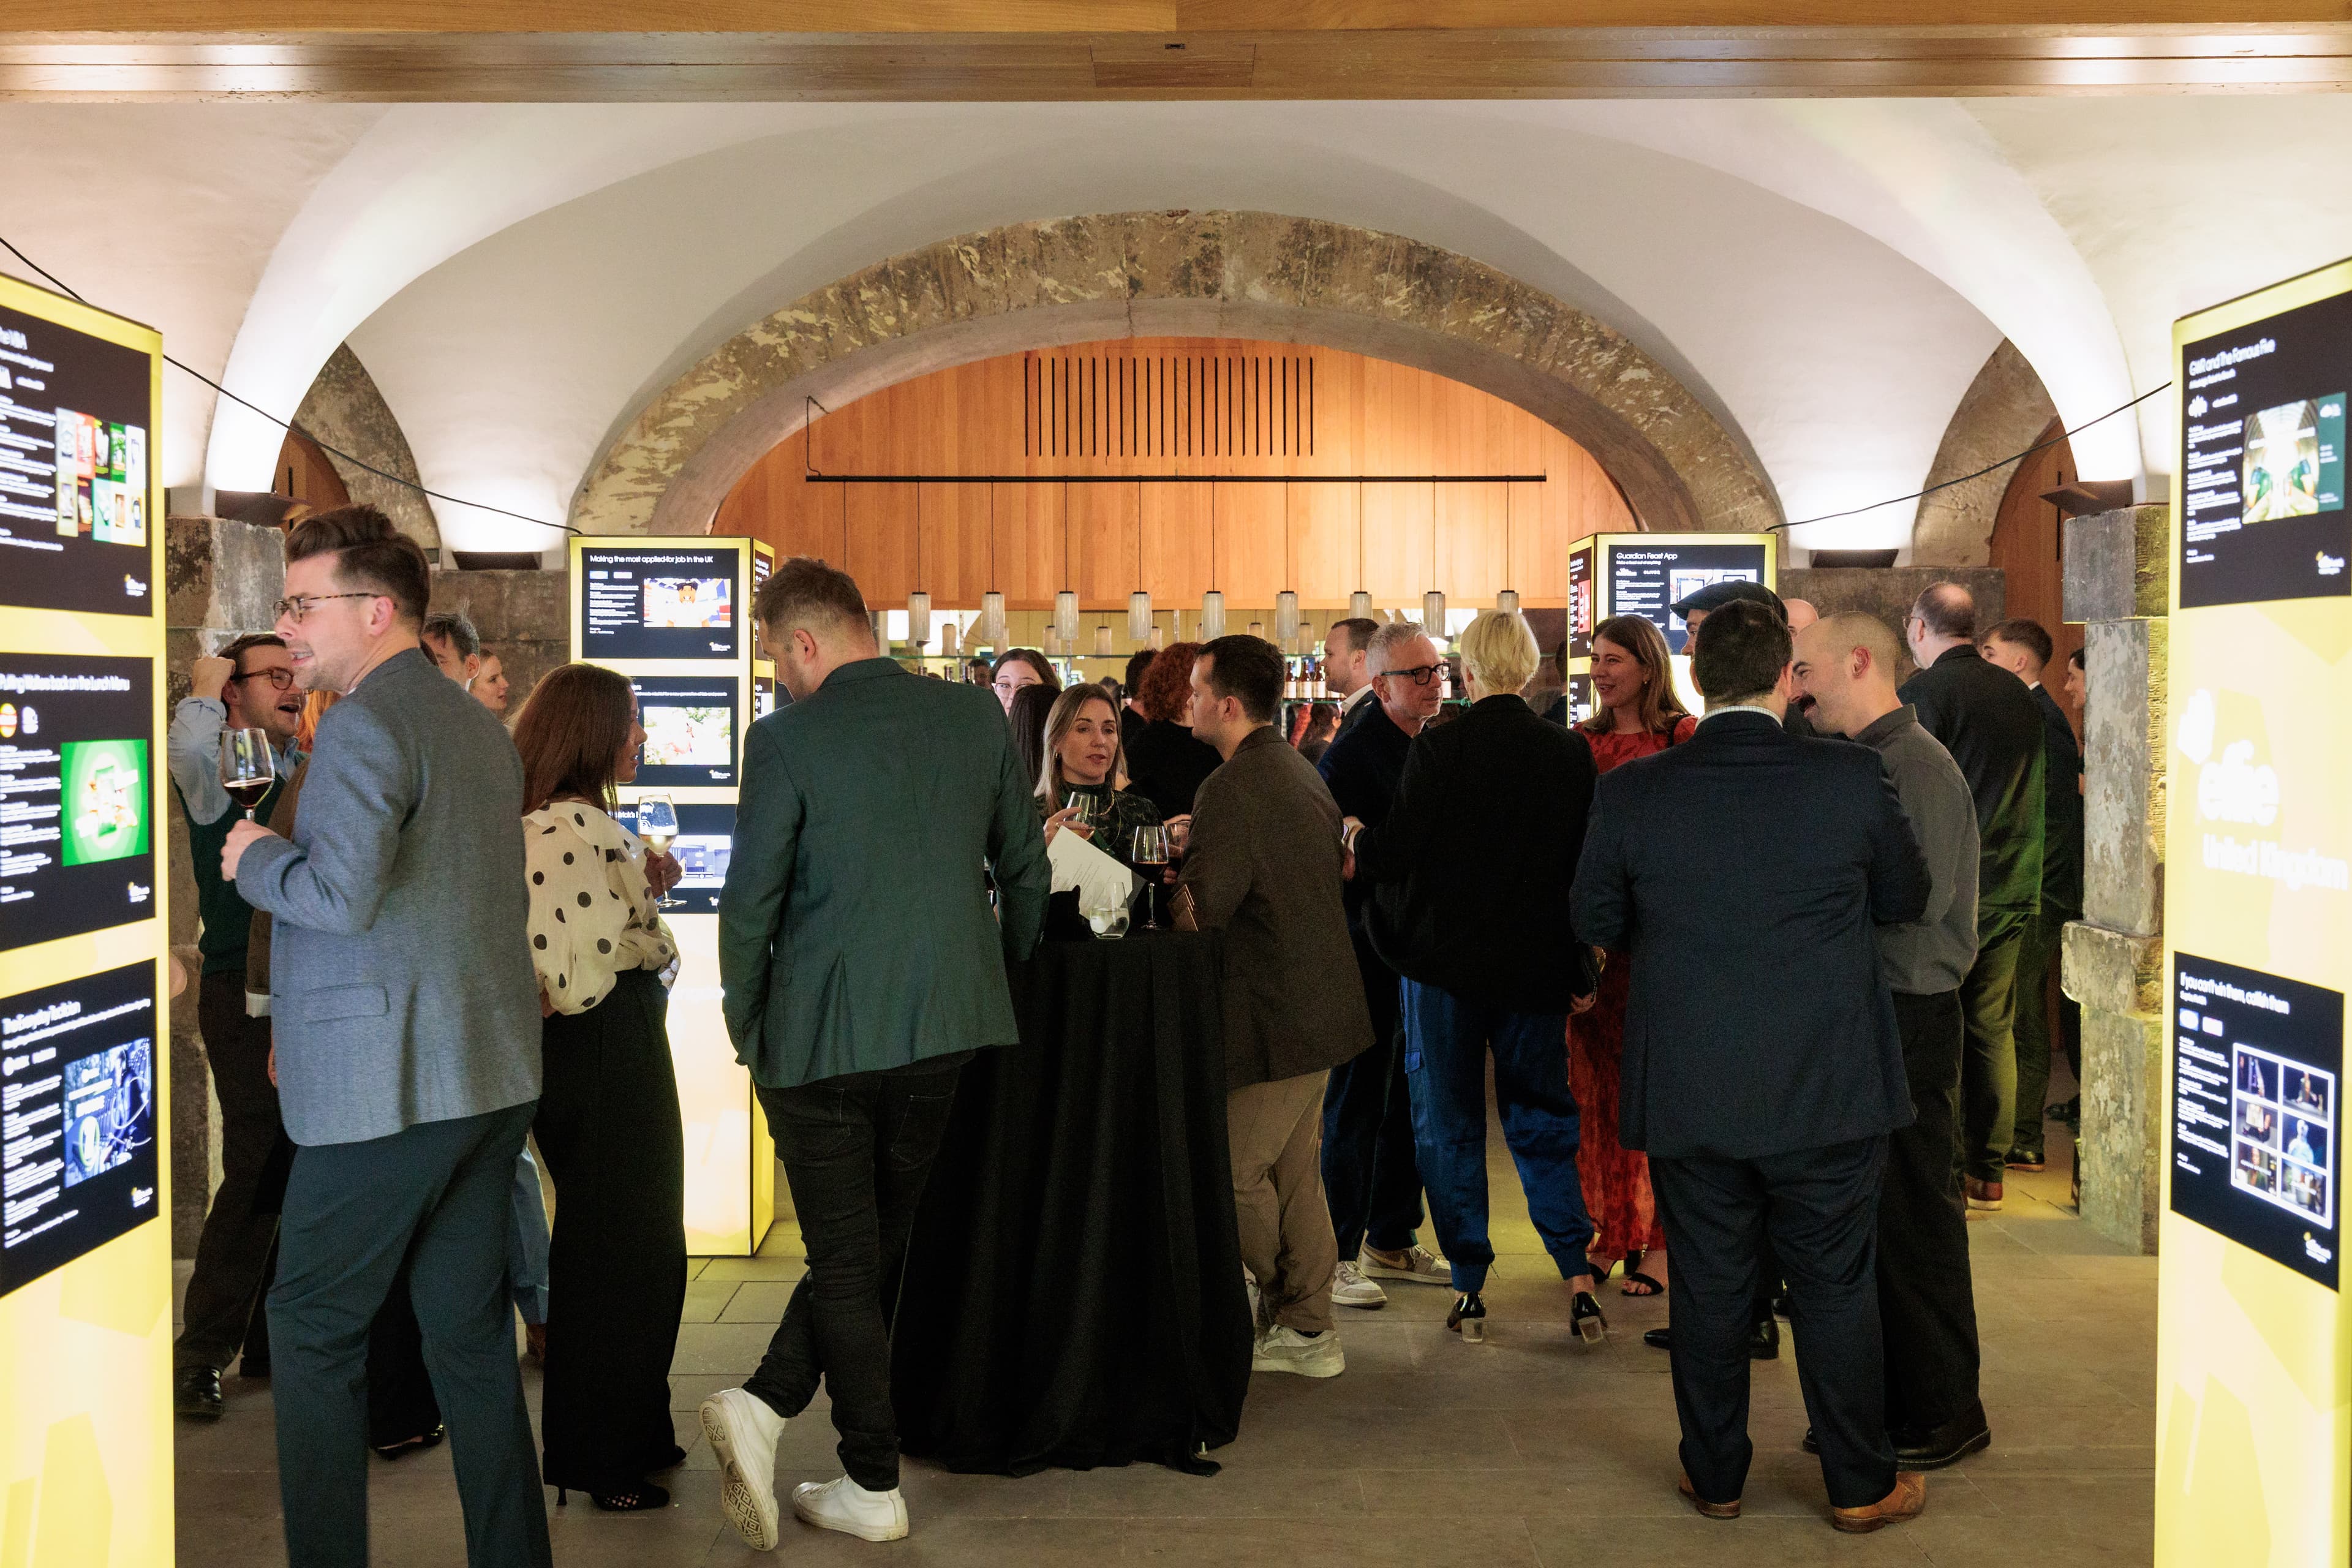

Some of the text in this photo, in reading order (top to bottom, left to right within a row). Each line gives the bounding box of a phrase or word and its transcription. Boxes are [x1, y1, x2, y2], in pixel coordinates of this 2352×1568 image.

[2233, 344, 2260, 363] Famous
[2203, 833, 2349, 892] United Kingdom
[2185, 976, 2198, 990] you
